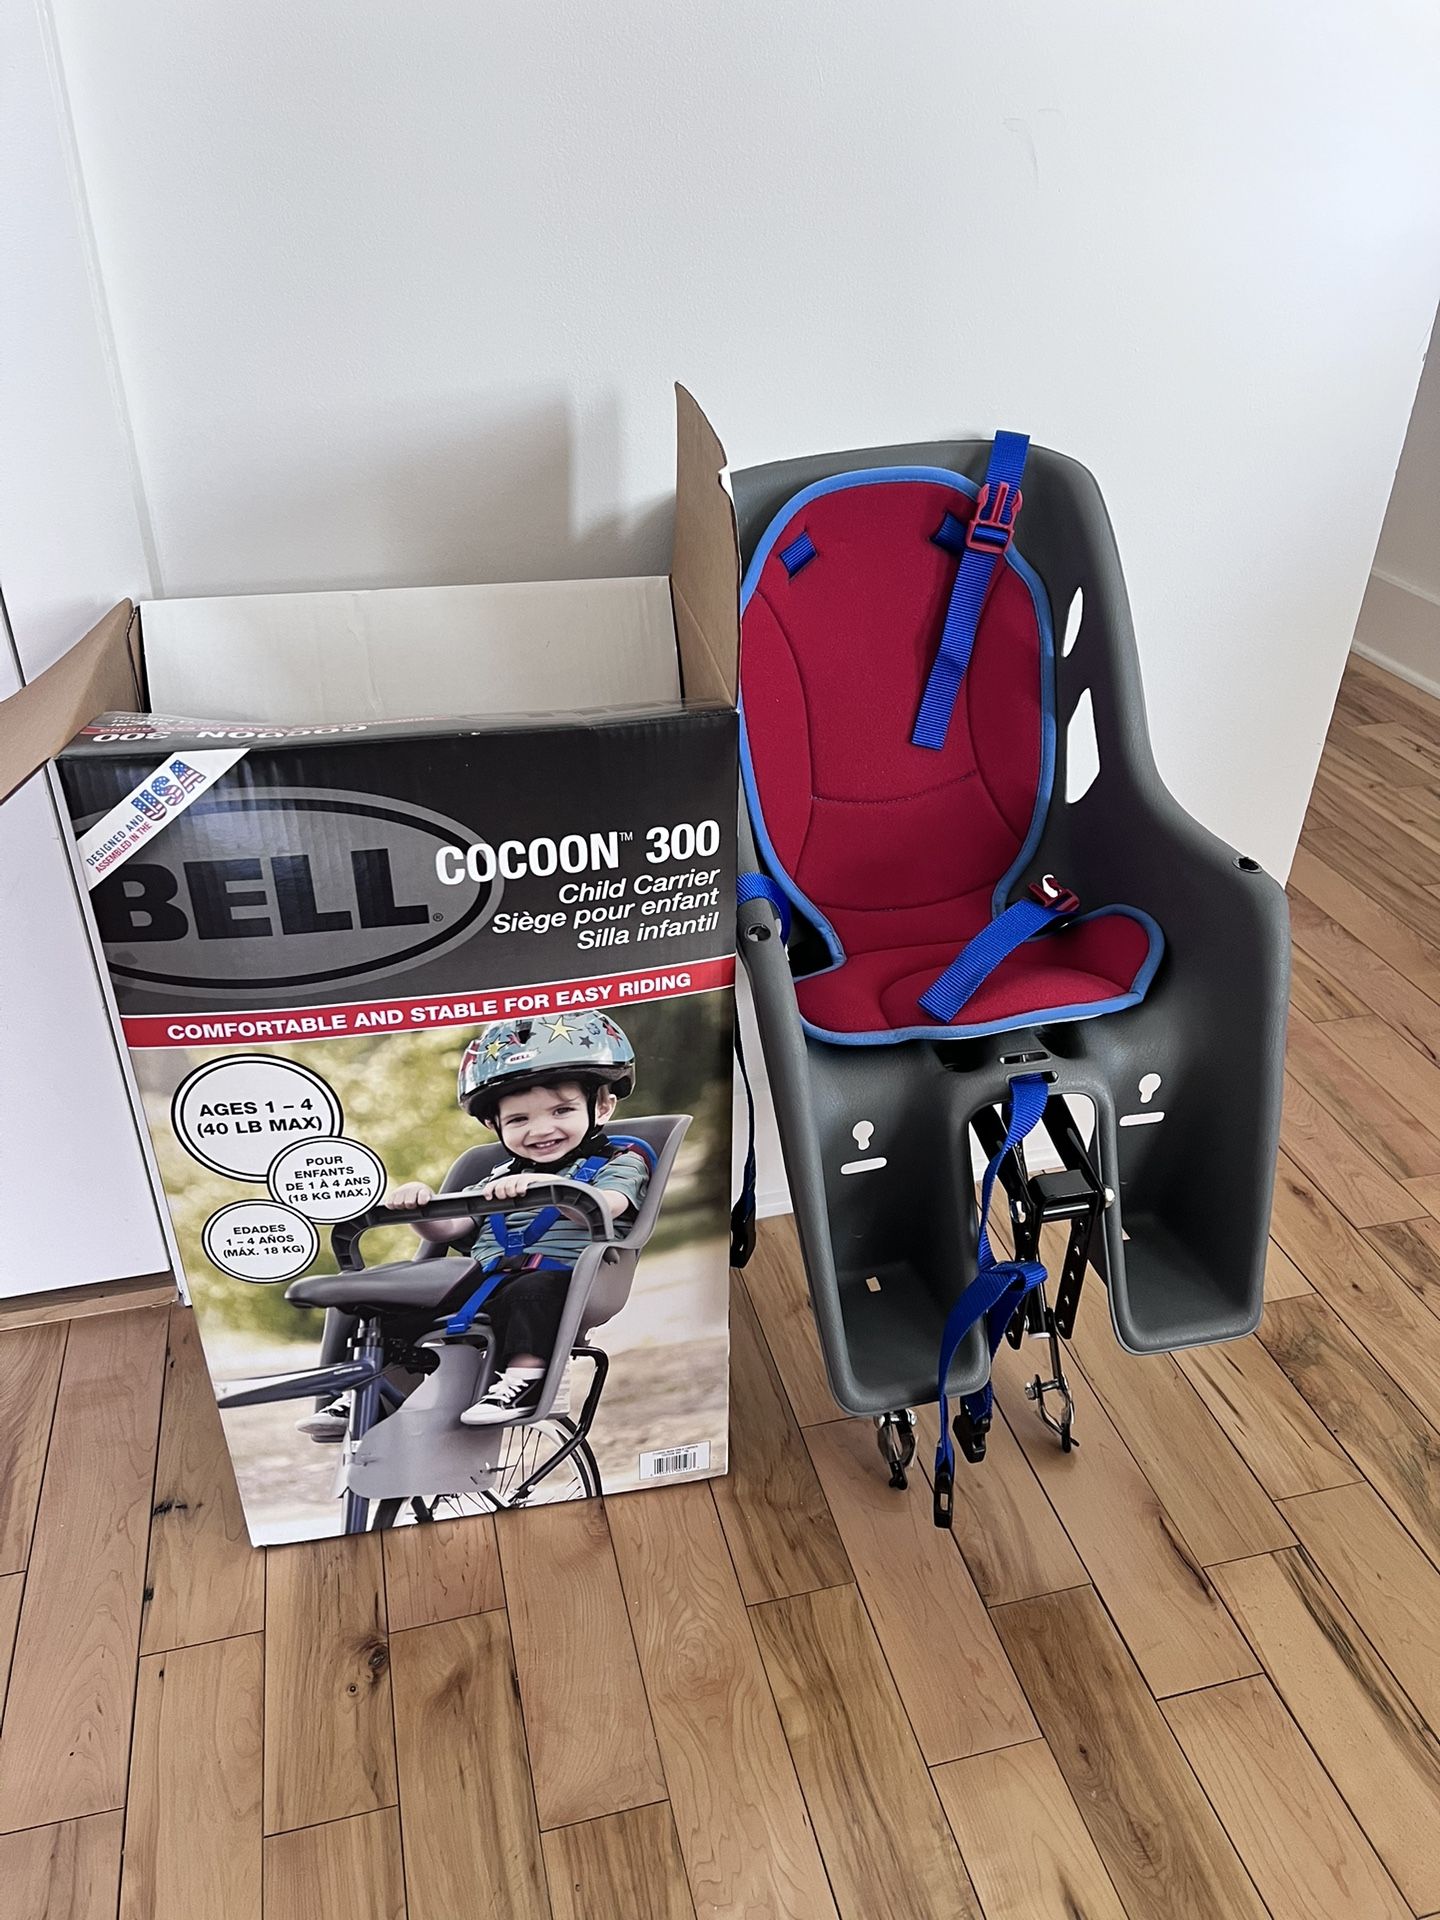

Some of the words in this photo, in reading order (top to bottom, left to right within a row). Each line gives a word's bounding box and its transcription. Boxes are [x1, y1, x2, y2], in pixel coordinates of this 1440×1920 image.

[92, 731, 169, 743] 300
[131, 759, 208, 821] USA
[86, 829, 127, 867] DESIGNED
[125, 814, 144, 833] AND
[96, 841, 133, 874] ASSEMBLED
[129, 832, 141, 846] IN
[136, 821, 153, 838] THE
[645, 820, 720, 864] 300
[558, 877, 627, 904] Child
[633, 868, 720, 895] Carrier
[492, 911, 567, 934] Siège
[573, 903, 635, 929] pour
[641, 887, 719, 916] enfant
[577, 930, 629, 950] Silla
[636, 912, 720, 942] infantil
[167, 1014, 347, 1040] COMFORTABLE
[354, 1008, 404, 1028] AND
[410, 1000, 498, 1022] STABLE
[504, 994, 550, 1012] FOR
[556, 985, 613, 1006] EASY
[619, 973, 691, 997] RIDING
[200, 1101, 258, 1117] AGES
[265, 1101, 275, 1113] 1
[301, 1098, 314, 1110] 4
[197, 1122, 229, 1138] (40
[236, 1120, 263, 1133] LB
[270, 1116, 323, 1132] MAX)
[306, 1155, 343, 1166] POUR
[294, 1166, 355, 1179] ENFANTS
[285, 1182, 304, 1191] DE
[309, 1181, 314, 1190] 1
[320, 1177, 330, 1189] À
[332, 1179, 341, 1188] 4
[344, 1176, 371, 1186] ANS
[288, 1193, 308, 1204] (18
[312, 1191, 331, 1200] KG
[335, 1187, 372, 1199] MAX.)
[226, 1238, 232, 1246] 1
[247, 1237, 255, 1245] 4
[258, 1233, 295, 1245] AÑOS
[233, 1224, 286, 1235] EDADES
[223, 1247, 260, 1259] (MÁX.
[265, 1246, 279, 1255] 18
[282, 1245, 305, 1255] KG)
